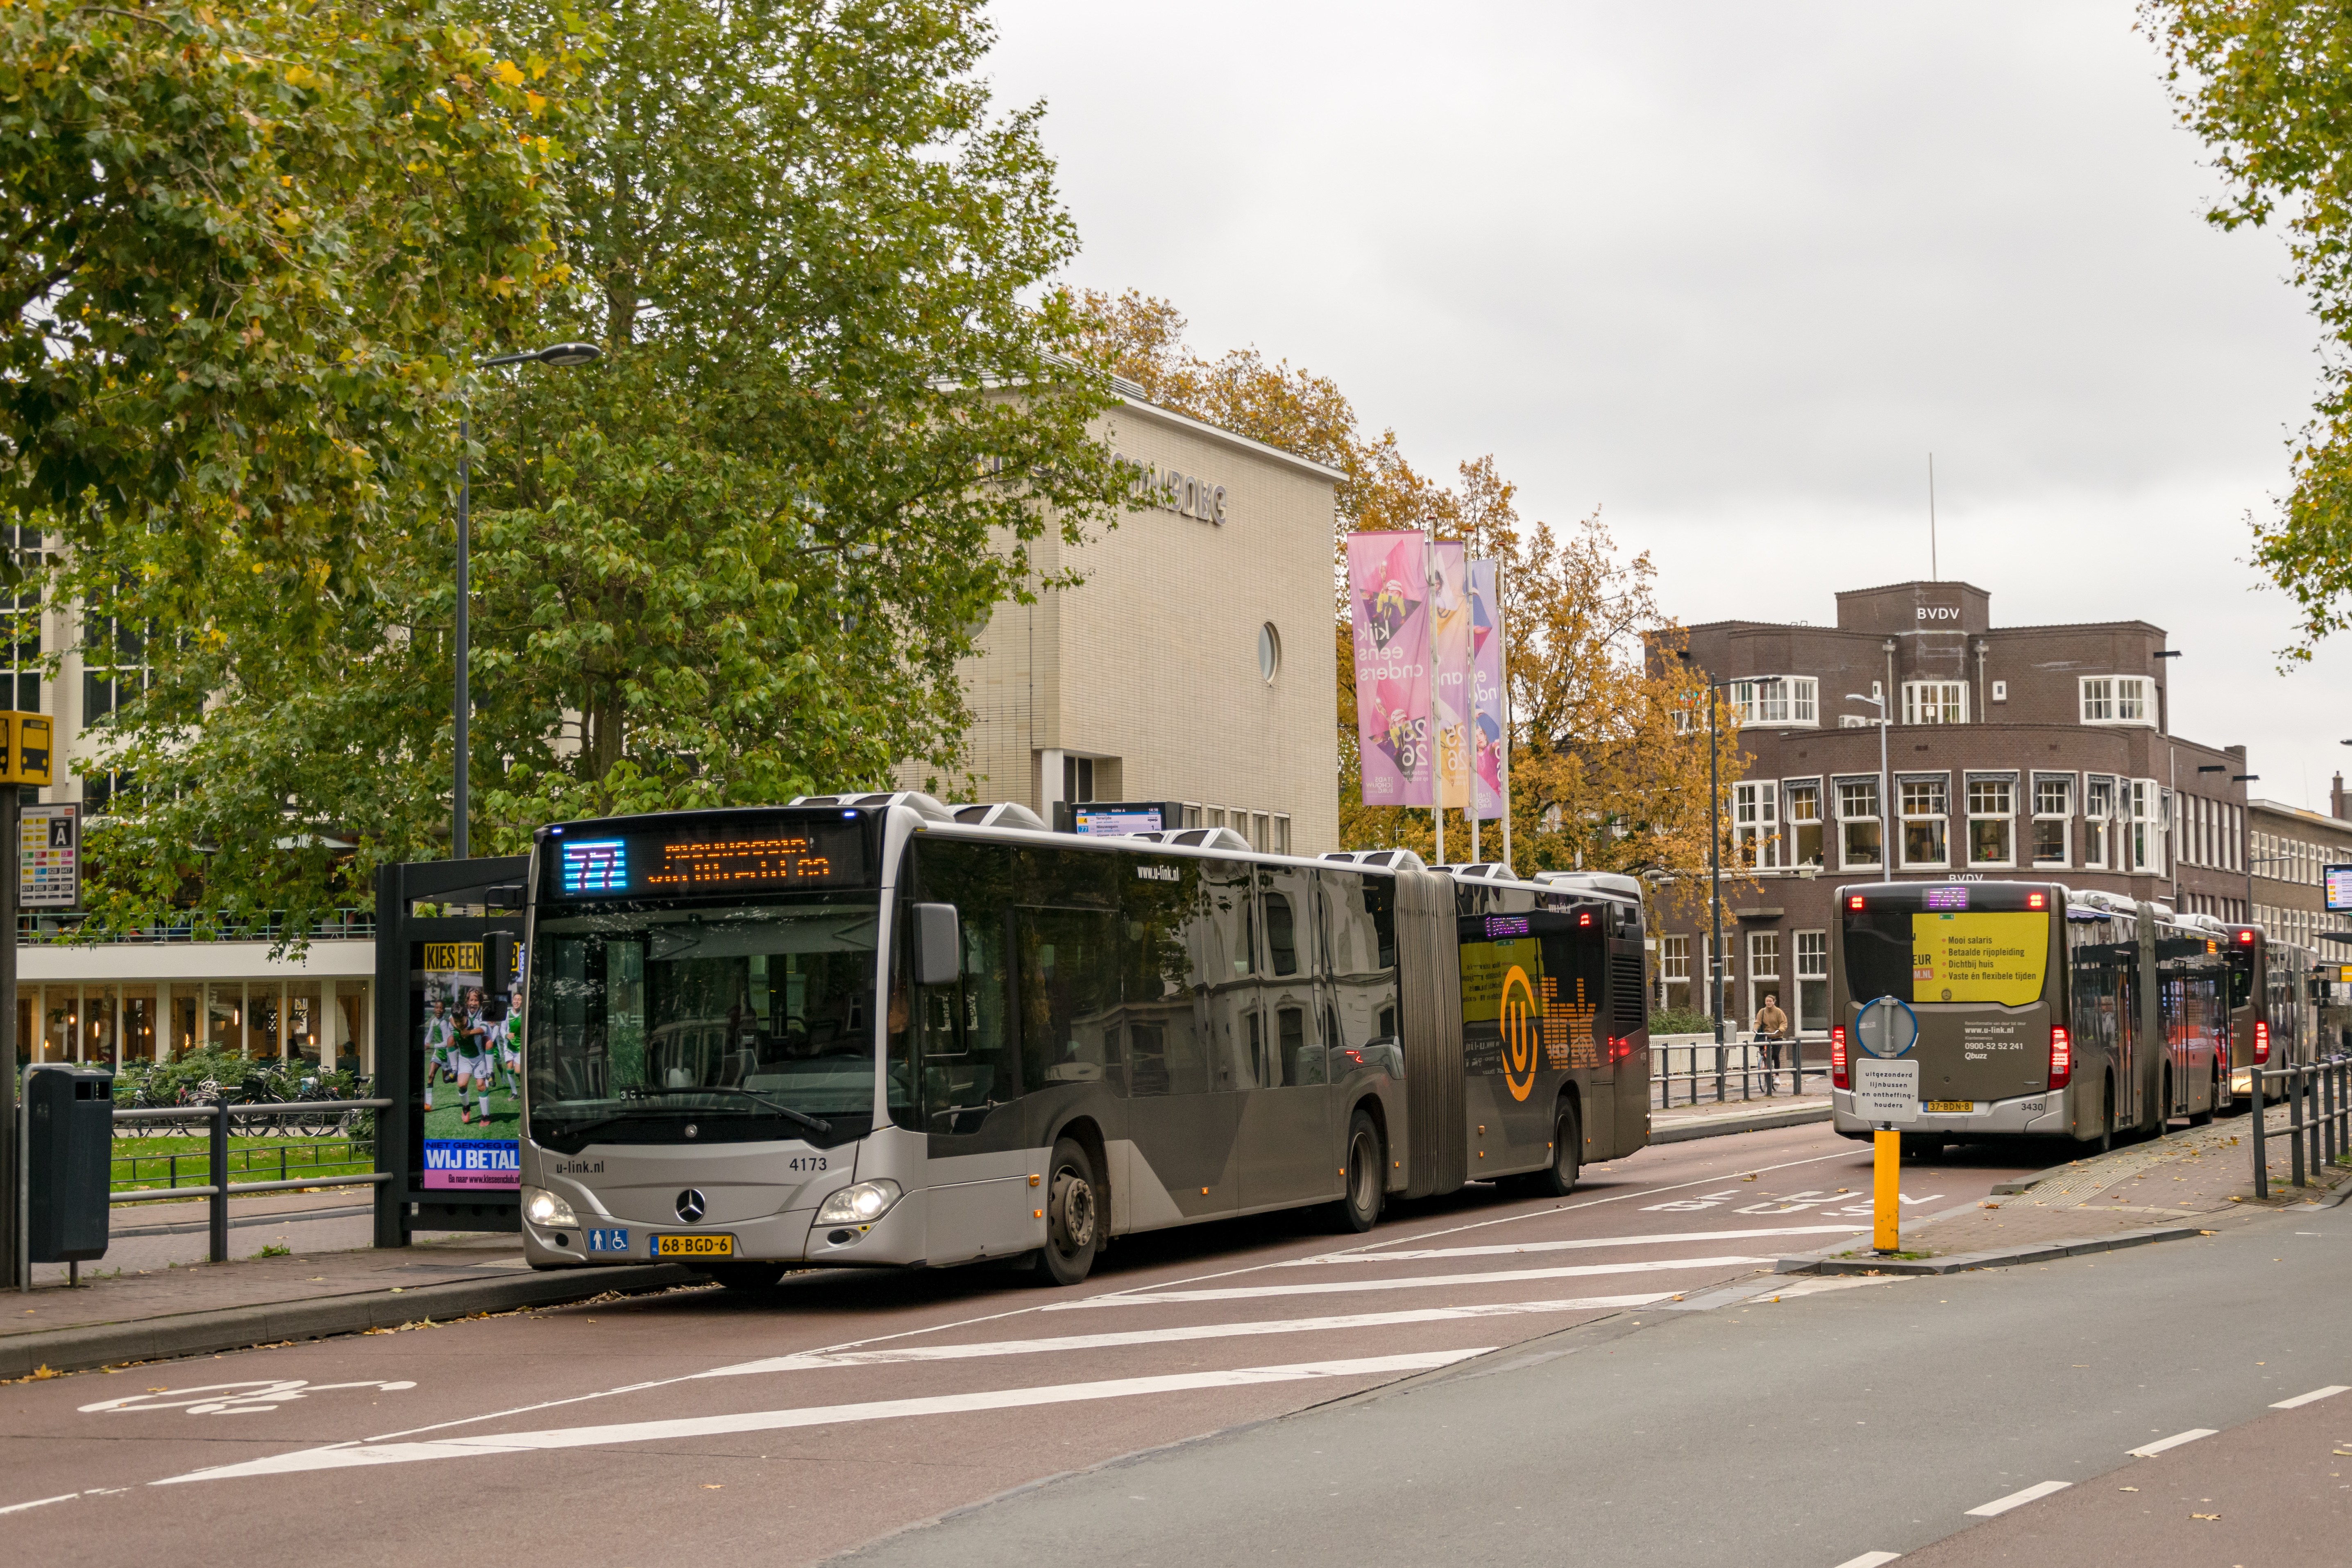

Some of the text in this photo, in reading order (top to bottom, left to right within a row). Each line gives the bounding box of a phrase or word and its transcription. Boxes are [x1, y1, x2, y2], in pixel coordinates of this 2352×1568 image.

[1917, 608, 1960, 619] BVDV
[55, 828, 66, 845] A
[1137, 865, 1179, 881] www.u-link.nl
[427, 945, 455, 970] KIES
[458, 945, 481, 970] EEN
[1983, 949, 2025, 957] rijopleiding
[1949, 960, 1976, 969] Dichtbij
[2015, 972, 2036, 981] tijden
[426, 1150, 519, 1169] WIJ BETAL
[789, 1157, 827, 1171] 4173
[557, 1160, 604, 1173] u-link.nl
[449, 1174, 455, 1183] Ga
[662, 1238, 728, 1252] 68-BGD-6
